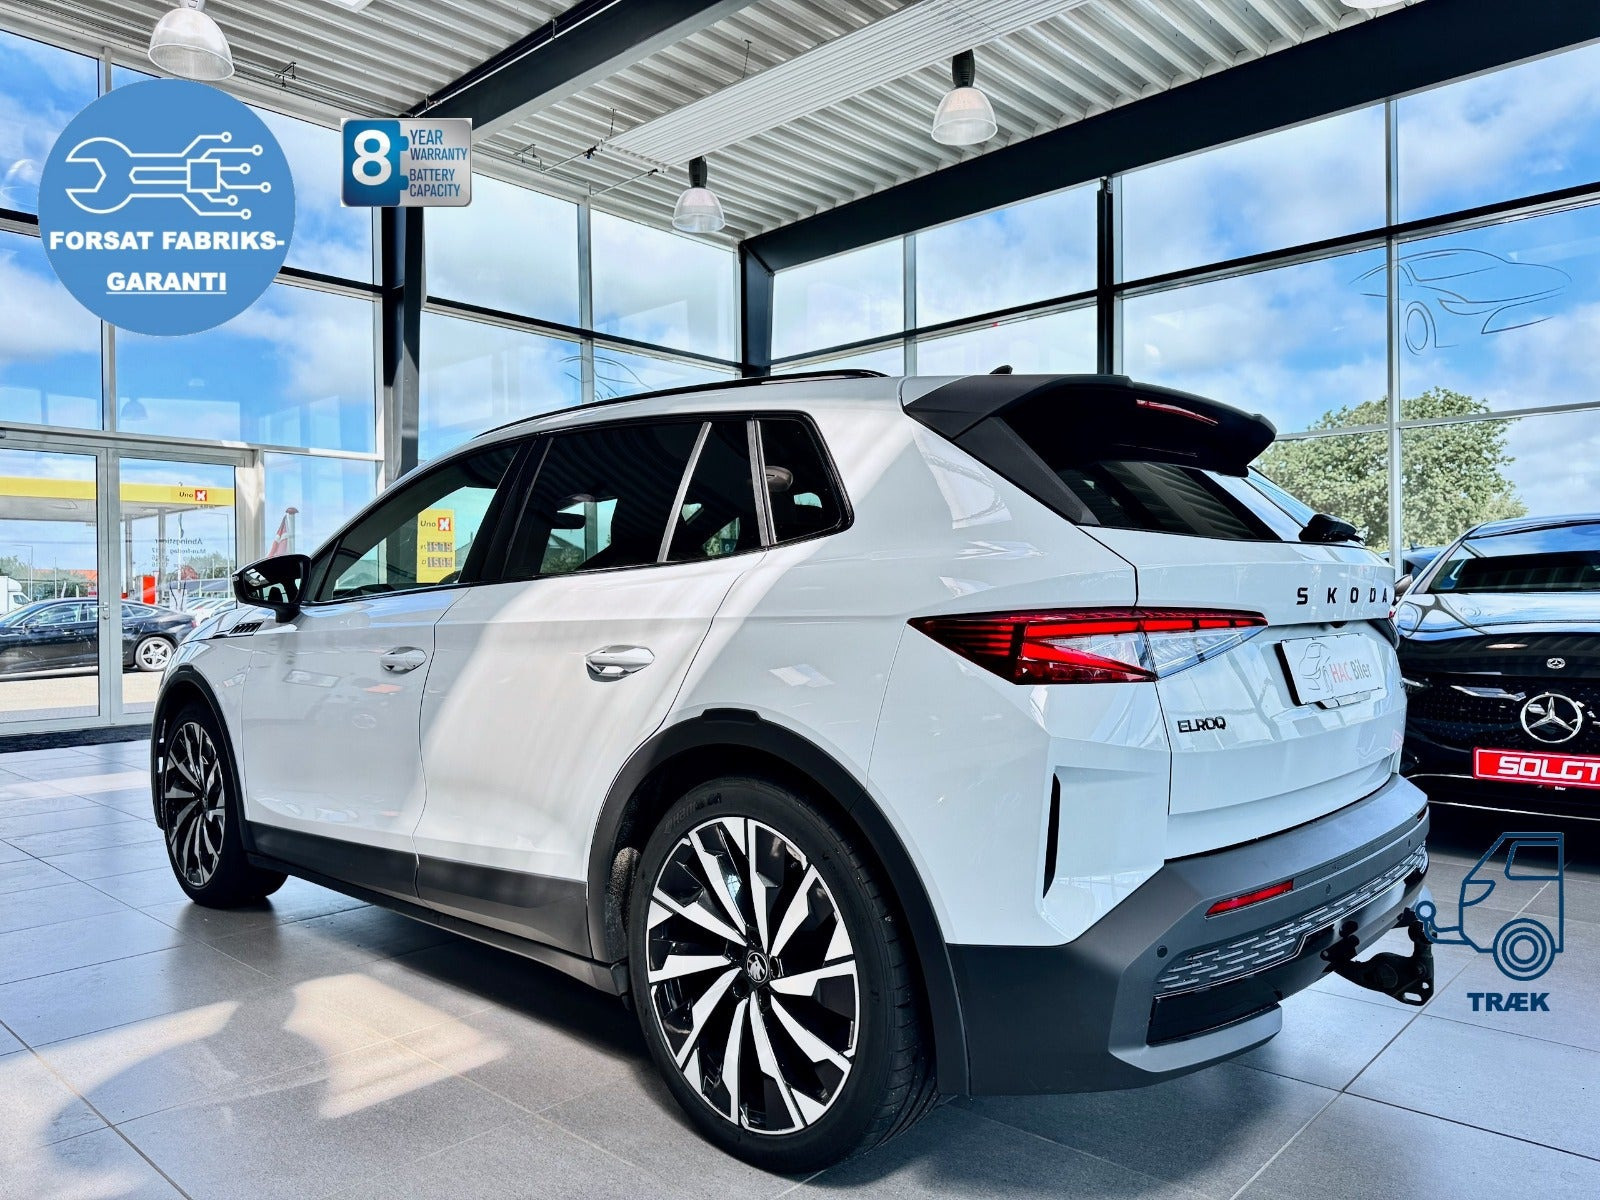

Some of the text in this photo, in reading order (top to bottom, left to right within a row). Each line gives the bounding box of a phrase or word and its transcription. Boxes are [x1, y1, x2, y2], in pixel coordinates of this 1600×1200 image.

[1296, 587, 1388, 605] SKODA
[1329, 659, 1372, 683] HAC Biler
[1177, 716, 1226, 733] ELROQ
[1497, 756, 1600, 781] SOLGT
